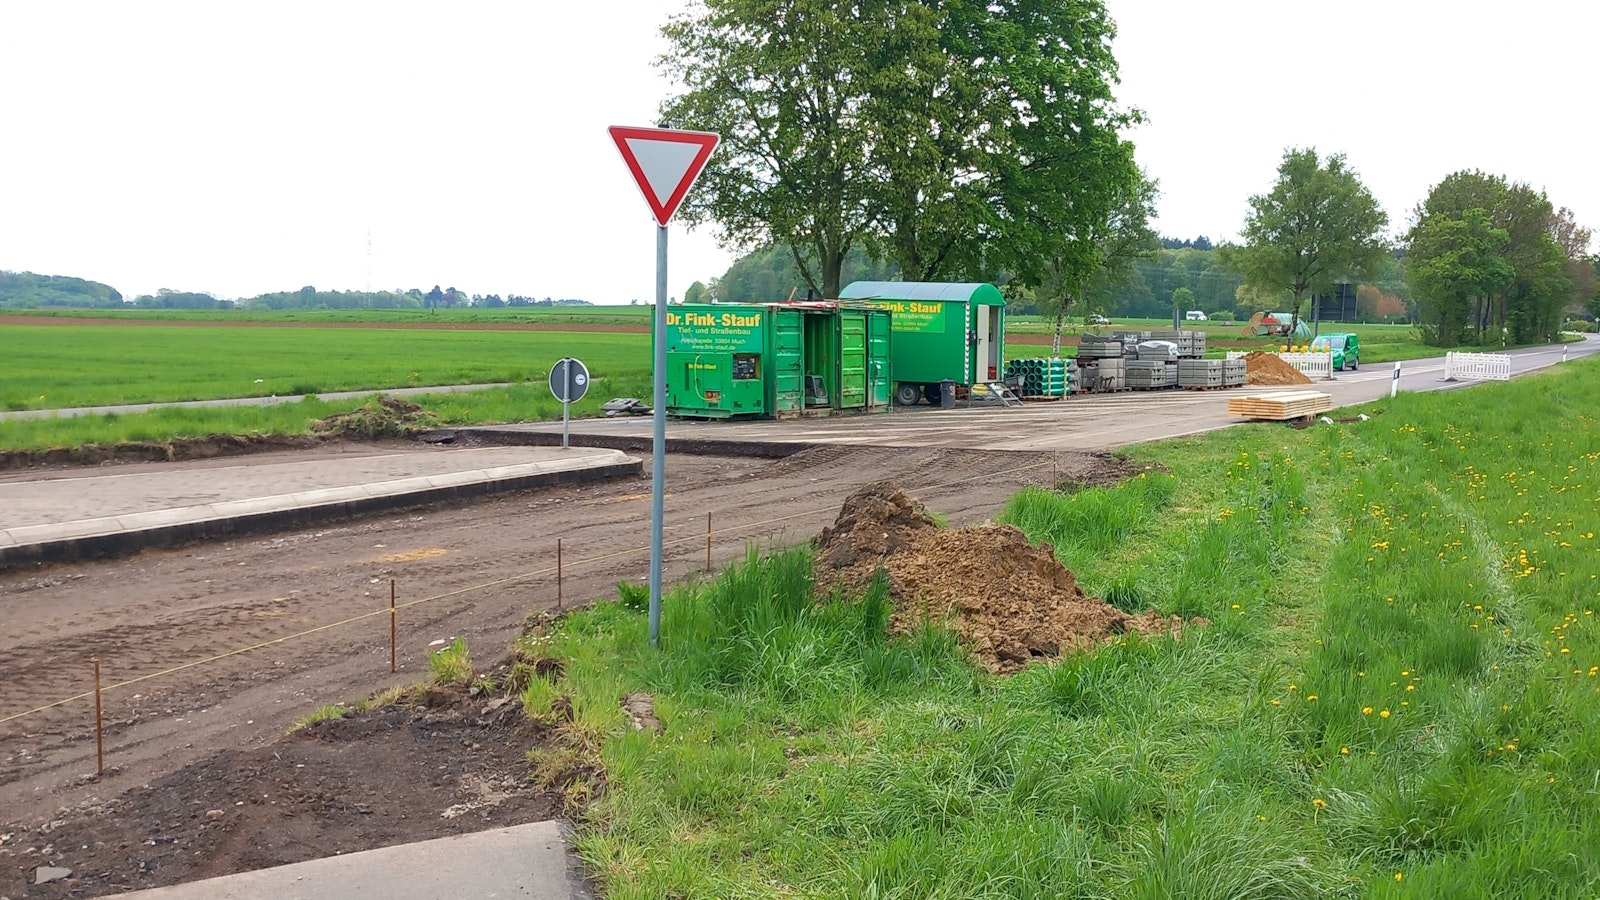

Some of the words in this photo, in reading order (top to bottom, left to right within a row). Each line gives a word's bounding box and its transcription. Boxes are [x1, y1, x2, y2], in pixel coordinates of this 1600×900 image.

[666, 312, 684, 326] Dr.
[685, 312, 761, 327] Fink-Stauf
[710, 327, 751, 335] Straßenbau
